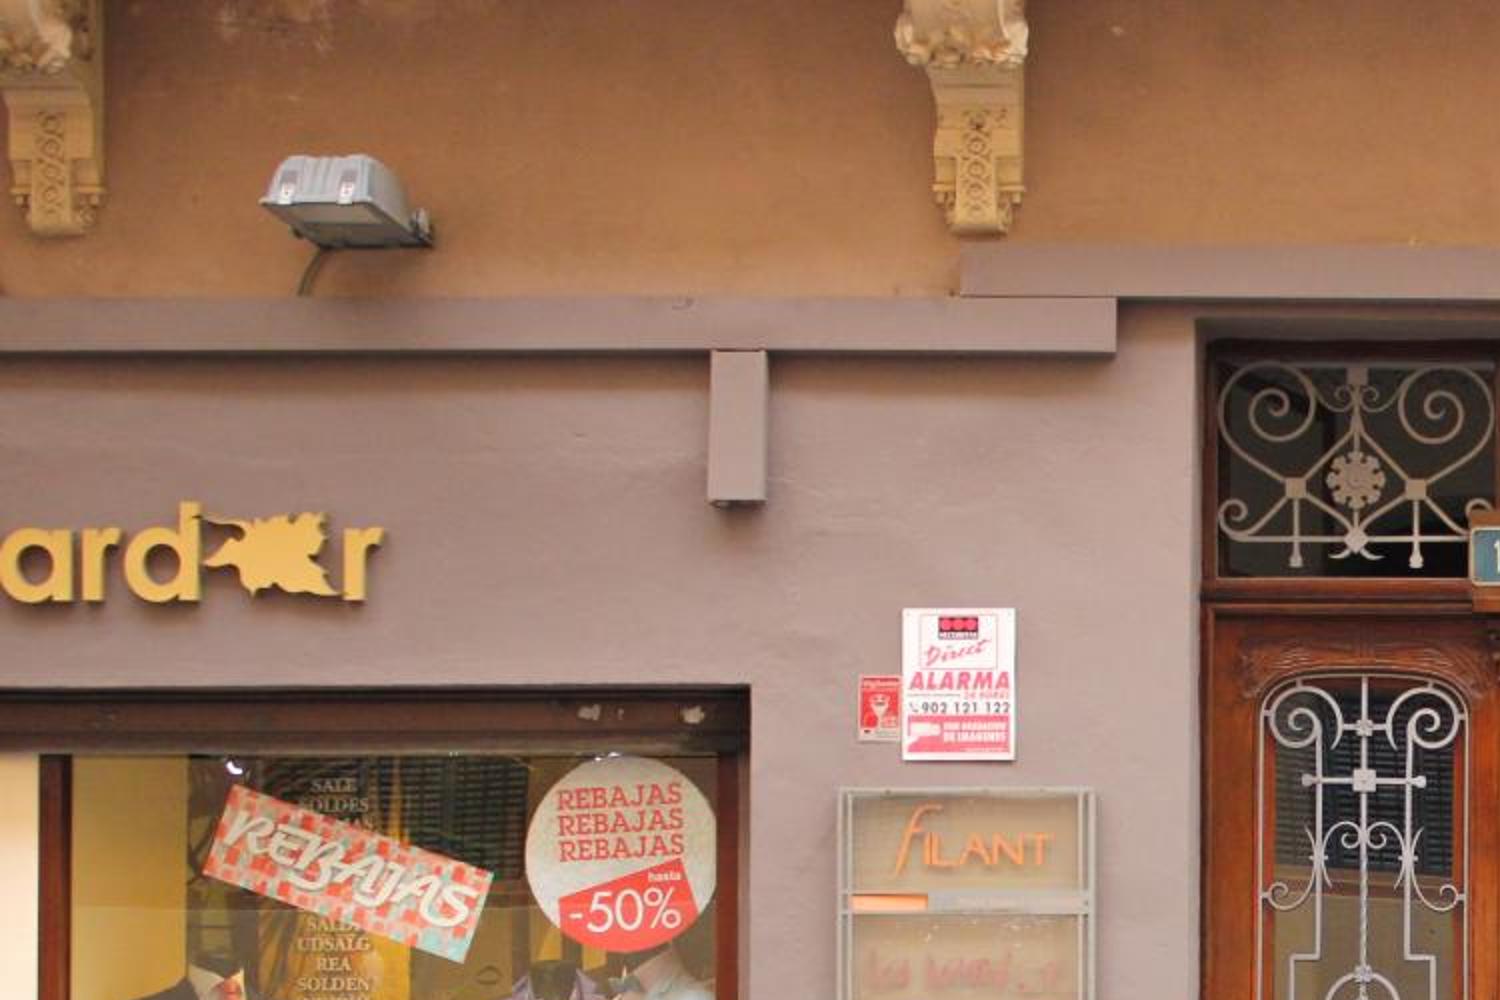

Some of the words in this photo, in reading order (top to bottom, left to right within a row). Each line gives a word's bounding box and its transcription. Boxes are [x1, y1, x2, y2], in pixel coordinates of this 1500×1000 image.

[908, 671, 1010, 690] ALARMA
[921, 702, 948, 714] 902
[954, 702, 978, 714] 121
[985, 702, 1011, 714] 122
[557, 782, 682, 811] REBAJAS
[557, 807, 684, 837] REBAJAS
[558, 833, 685, 863] REBAJAS
[222, 809, 480, 928] REBAJAS
[647, 871, 682, 882] hasta
[568, 886, 682, 933] -50%
[297, 937, 371, 952] UDSALG
[316, 957, 352, 972] REA
